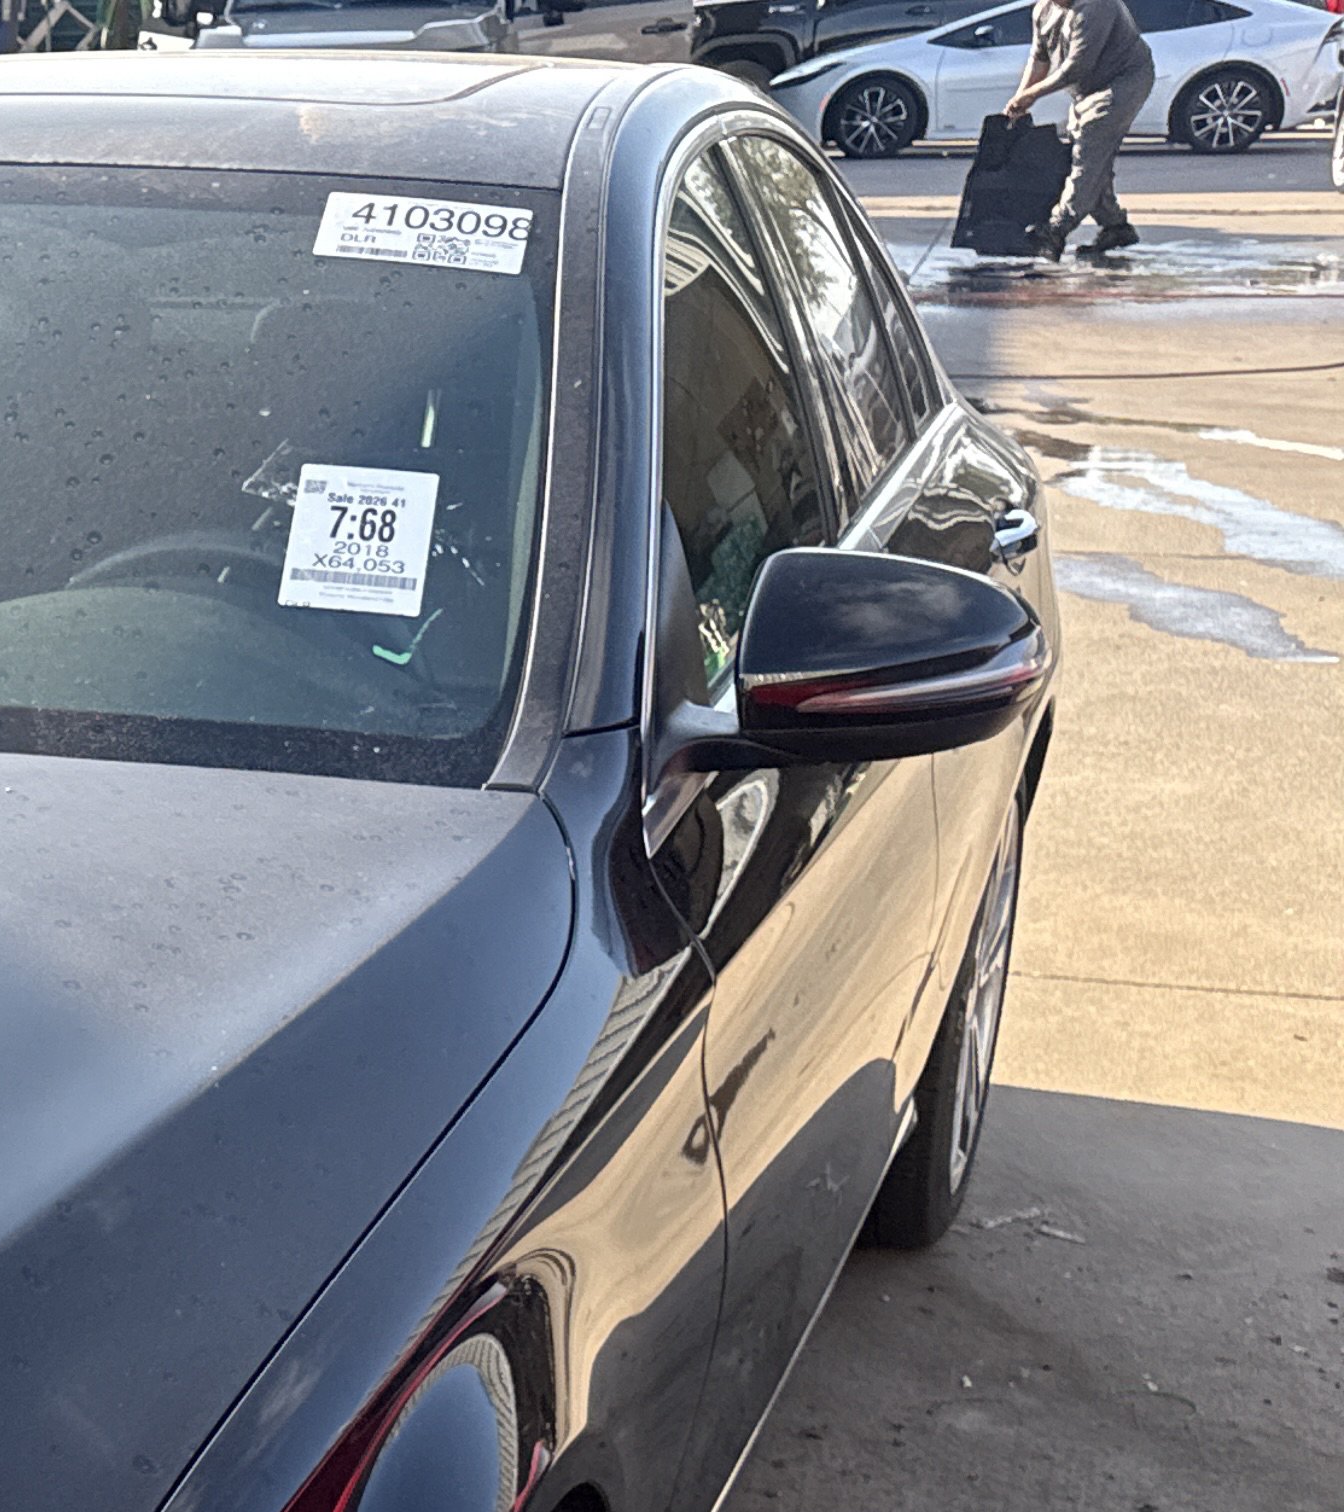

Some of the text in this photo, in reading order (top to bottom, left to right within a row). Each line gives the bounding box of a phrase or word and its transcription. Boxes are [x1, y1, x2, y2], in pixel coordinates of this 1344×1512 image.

[351, 202, 532, 241] 4103098
[327, 492, 354, 504] Sale
[391, 497, 406, 508] 41
[329, 505, 397, 543] 7:68
[333, 541, 390, 558] 2018
[311, 552, 406, 574] X64,053
